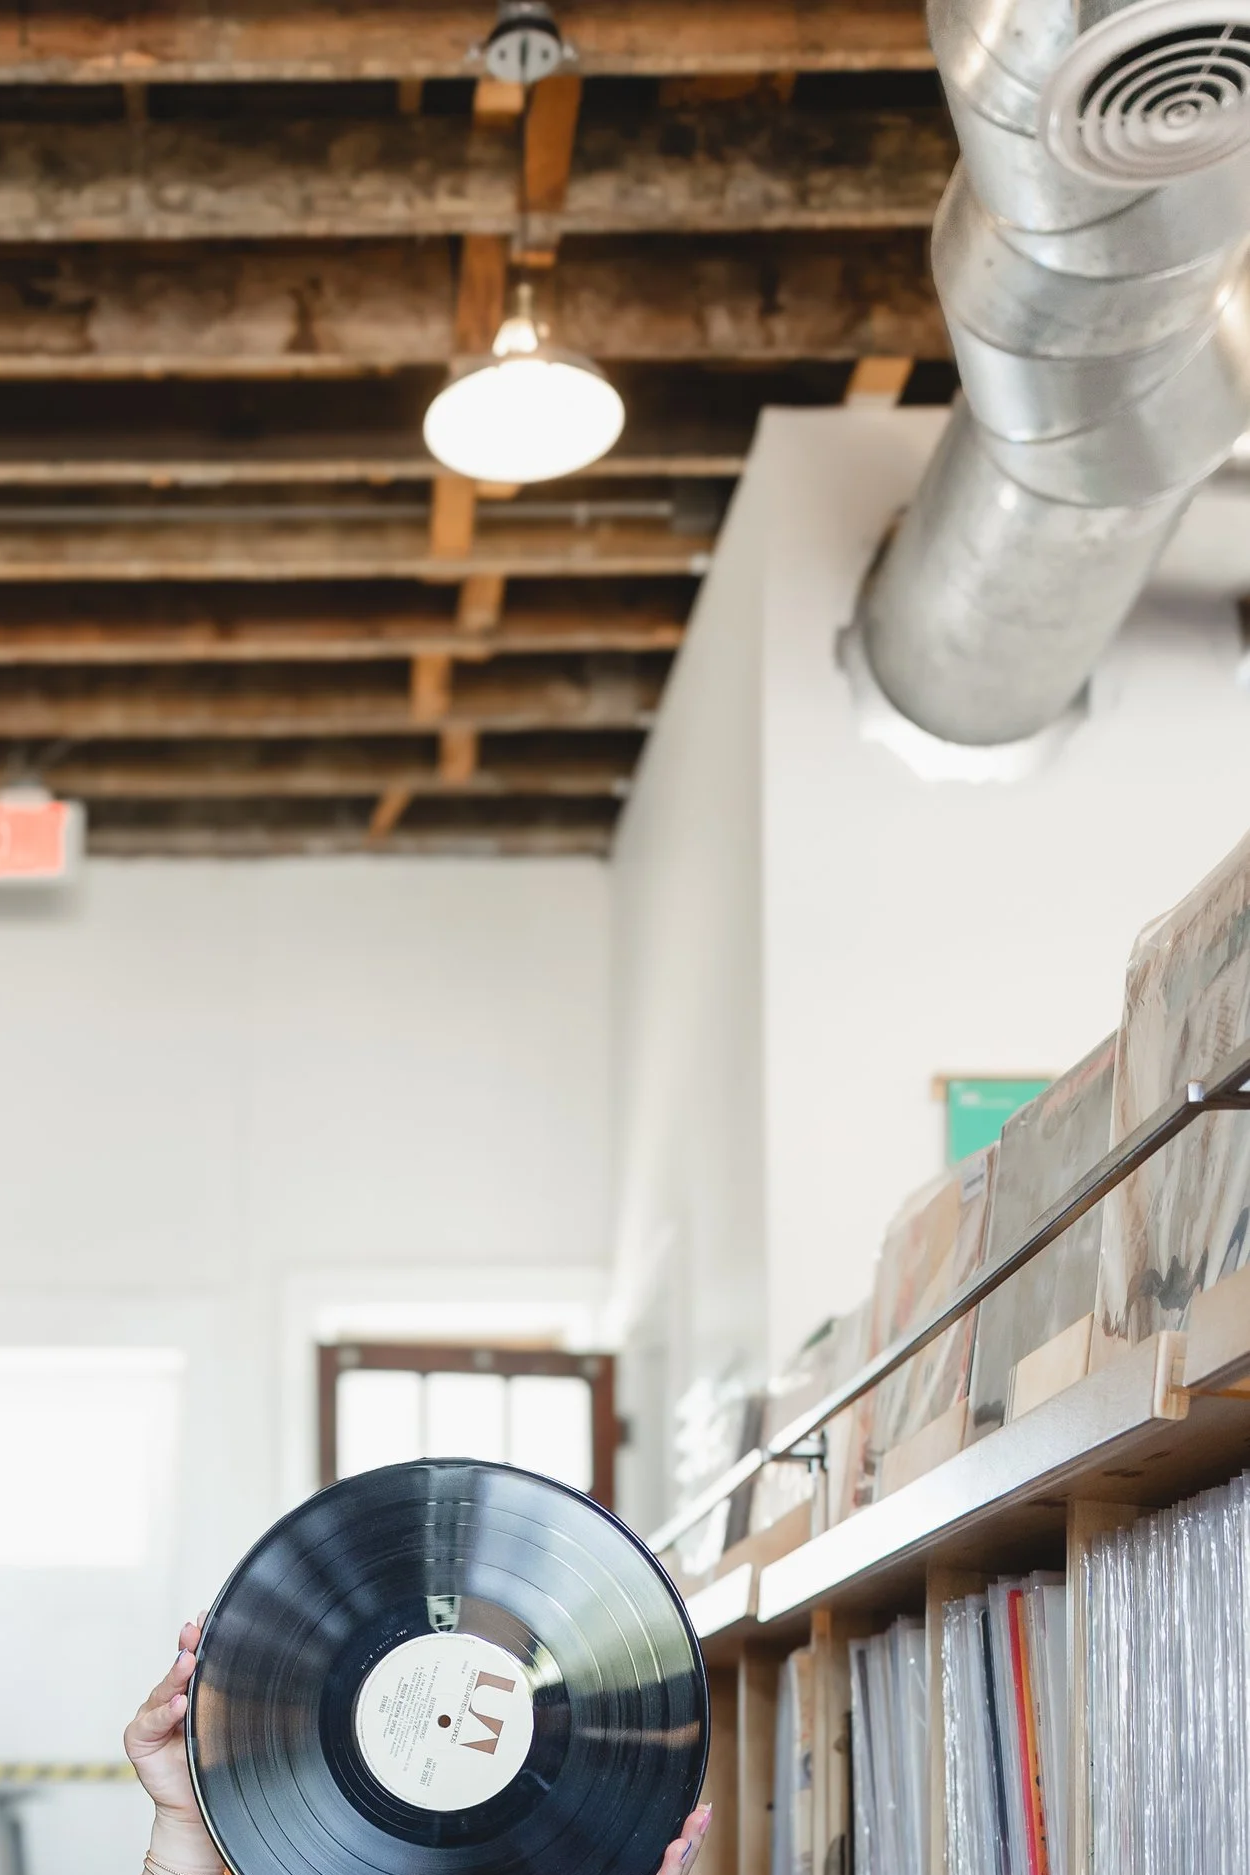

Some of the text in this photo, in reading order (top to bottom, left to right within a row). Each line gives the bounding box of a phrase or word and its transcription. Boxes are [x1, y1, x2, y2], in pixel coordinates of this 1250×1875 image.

[450, 1668, 477, 1744] UNITED ARTISTS RECORDS
